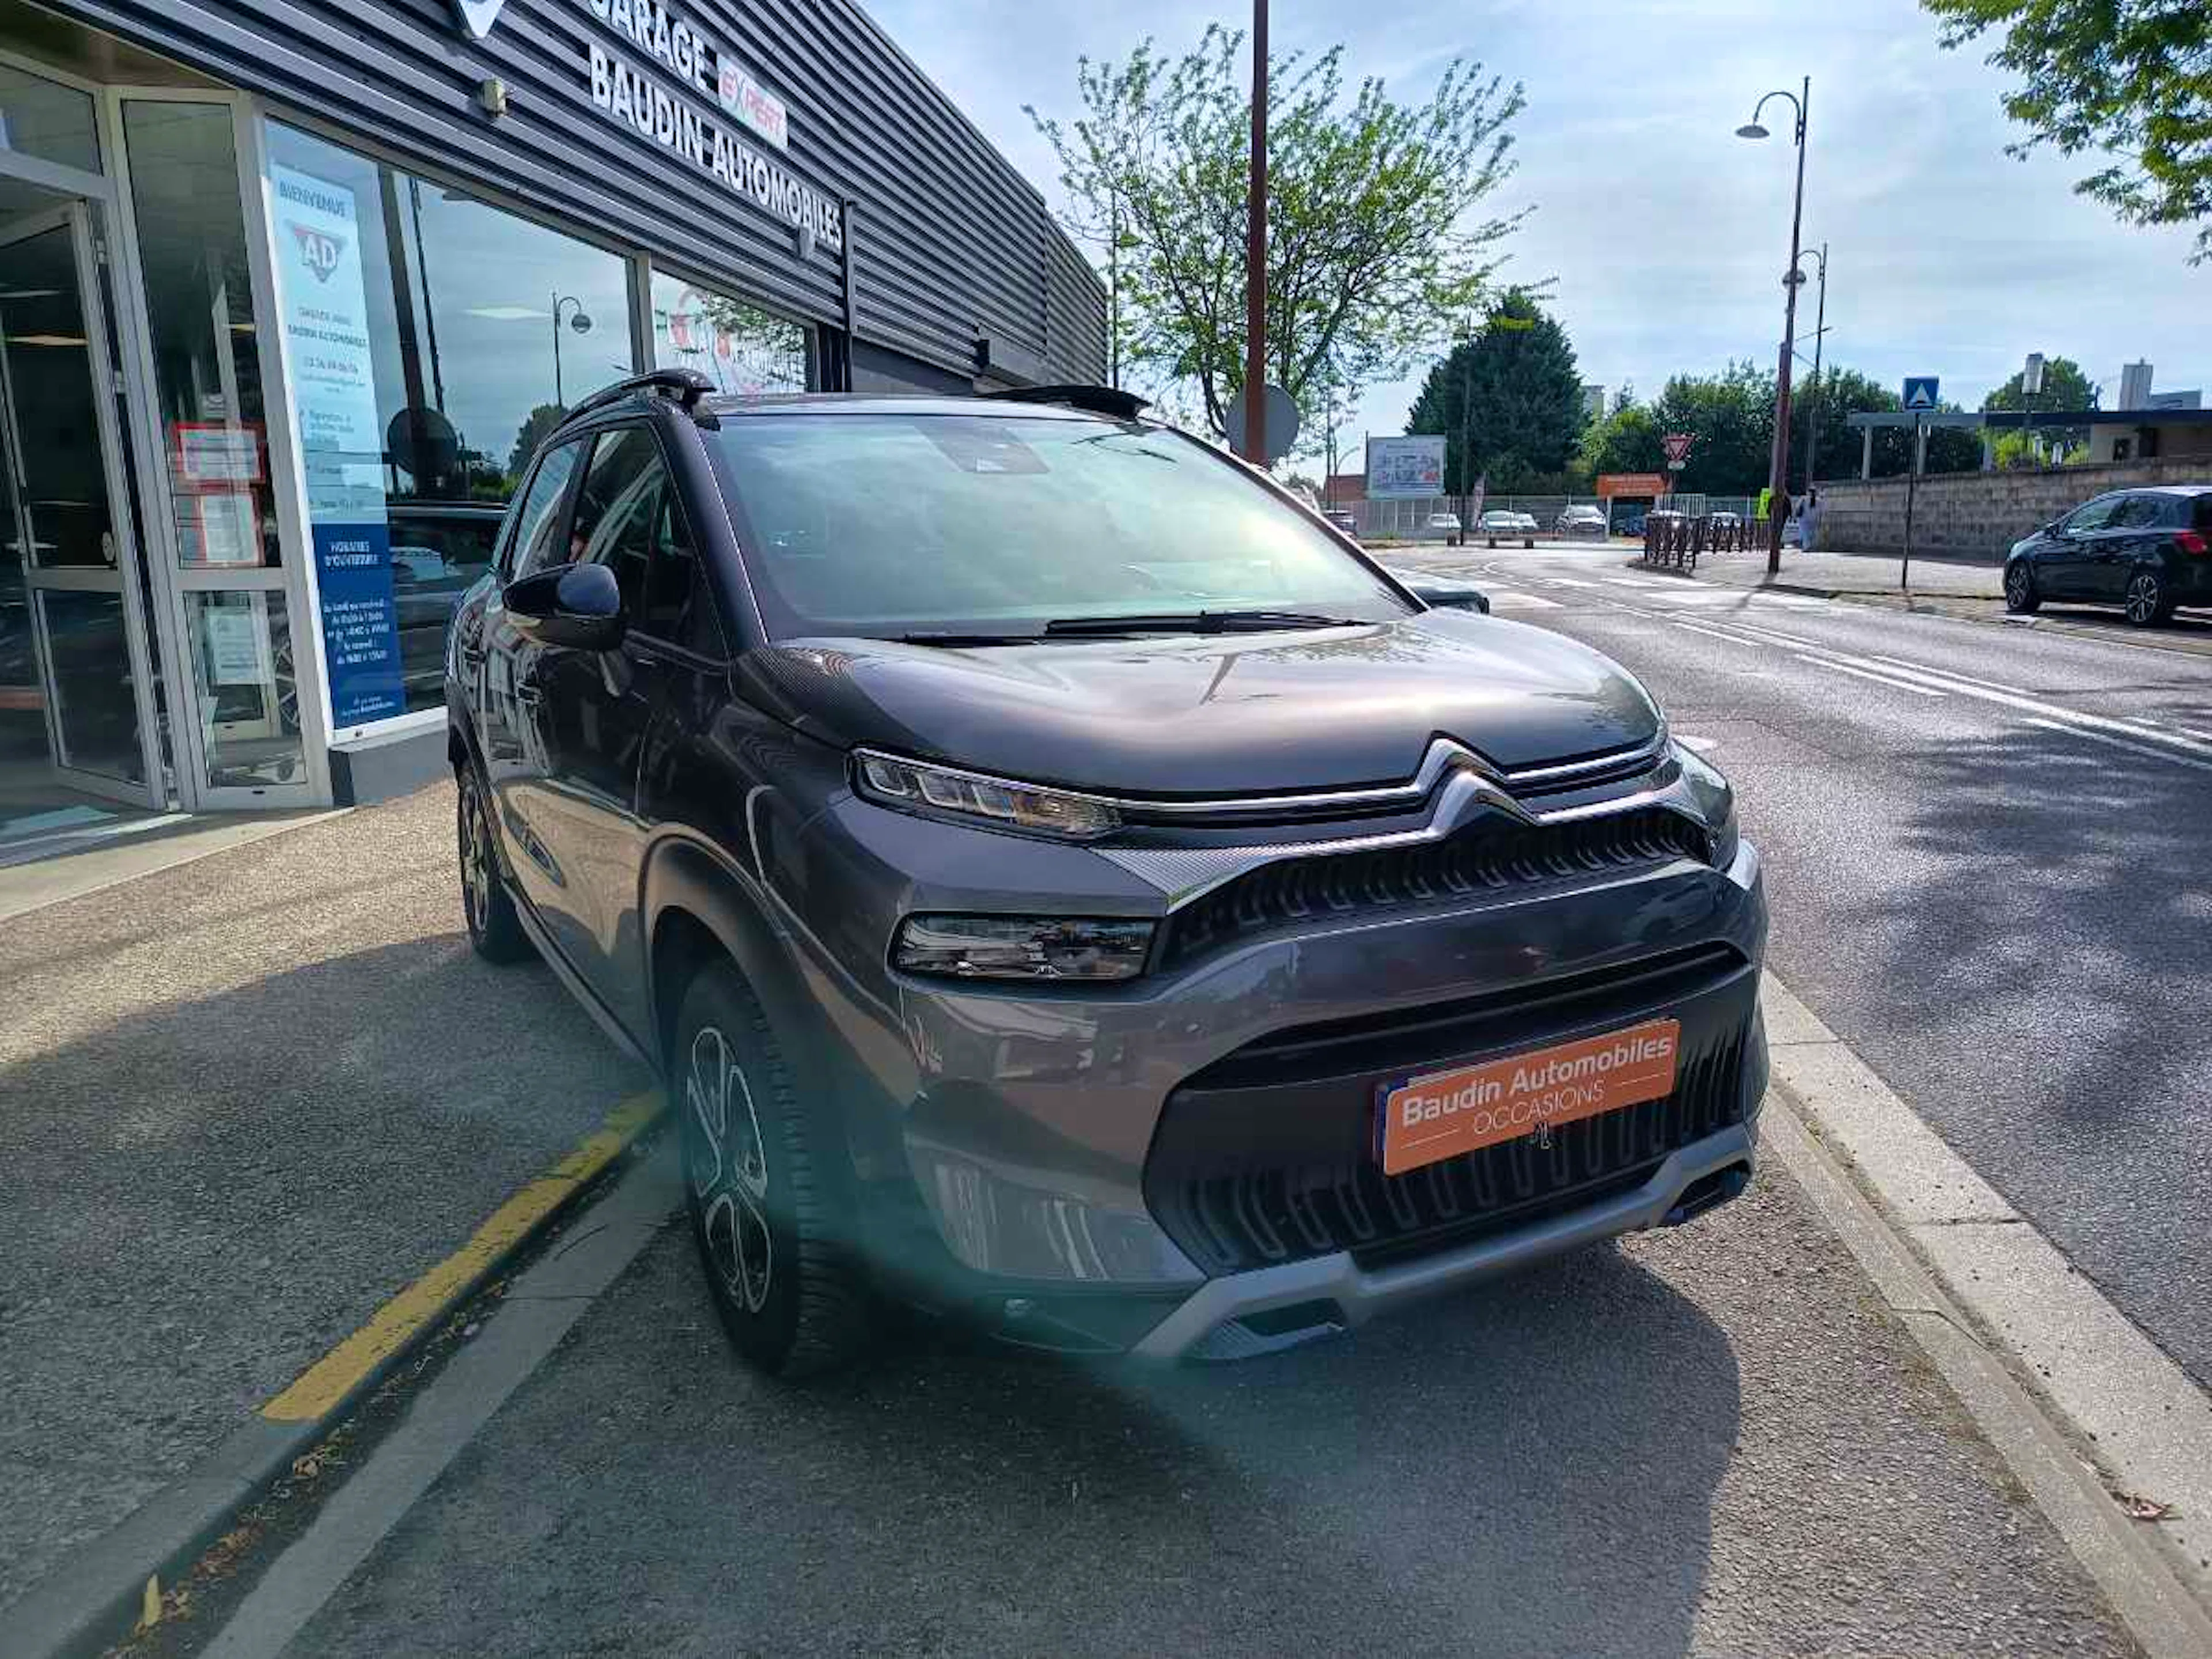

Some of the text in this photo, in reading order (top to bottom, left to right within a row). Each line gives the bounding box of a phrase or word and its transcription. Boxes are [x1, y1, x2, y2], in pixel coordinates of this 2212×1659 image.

[589, 42, 842, 251] BAUDIN AUTOMOBILES
[302, 233, 338, 268] AD
[1402, 1036, 1673, 1127] Baudin Automobiles
[1473, 1079, 1605, 1135] OCCASIONS
